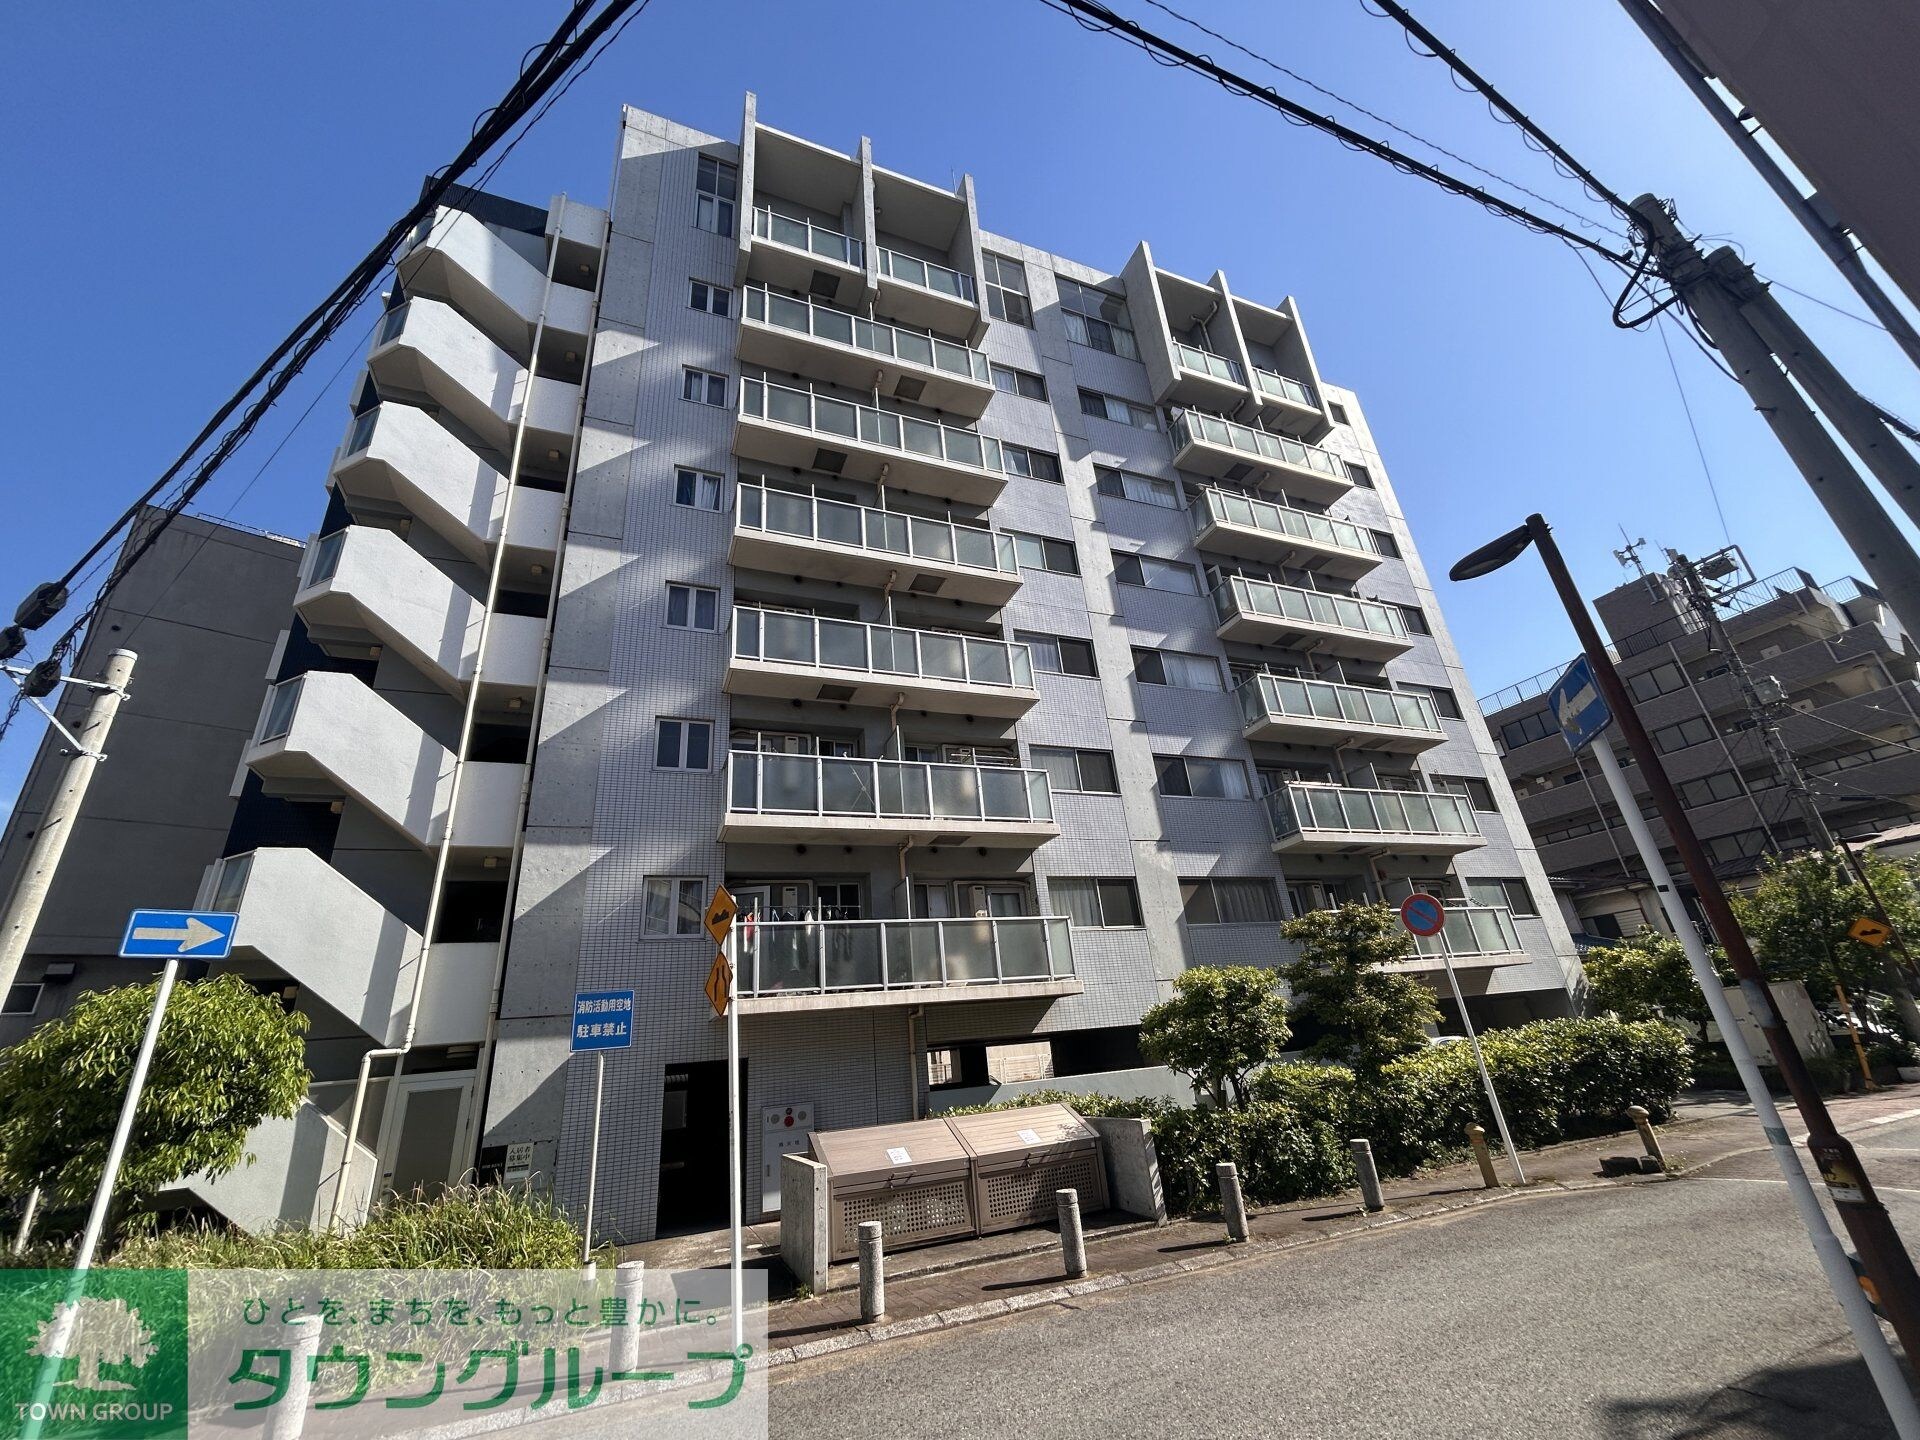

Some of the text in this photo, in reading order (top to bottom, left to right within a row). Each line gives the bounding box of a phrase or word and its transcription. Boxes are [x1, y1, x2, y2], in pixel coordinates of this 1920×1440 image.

[577, 998, 631, 1014] 消防活動用空地
[577, 1022, 626, 1038] 駐車禁止
